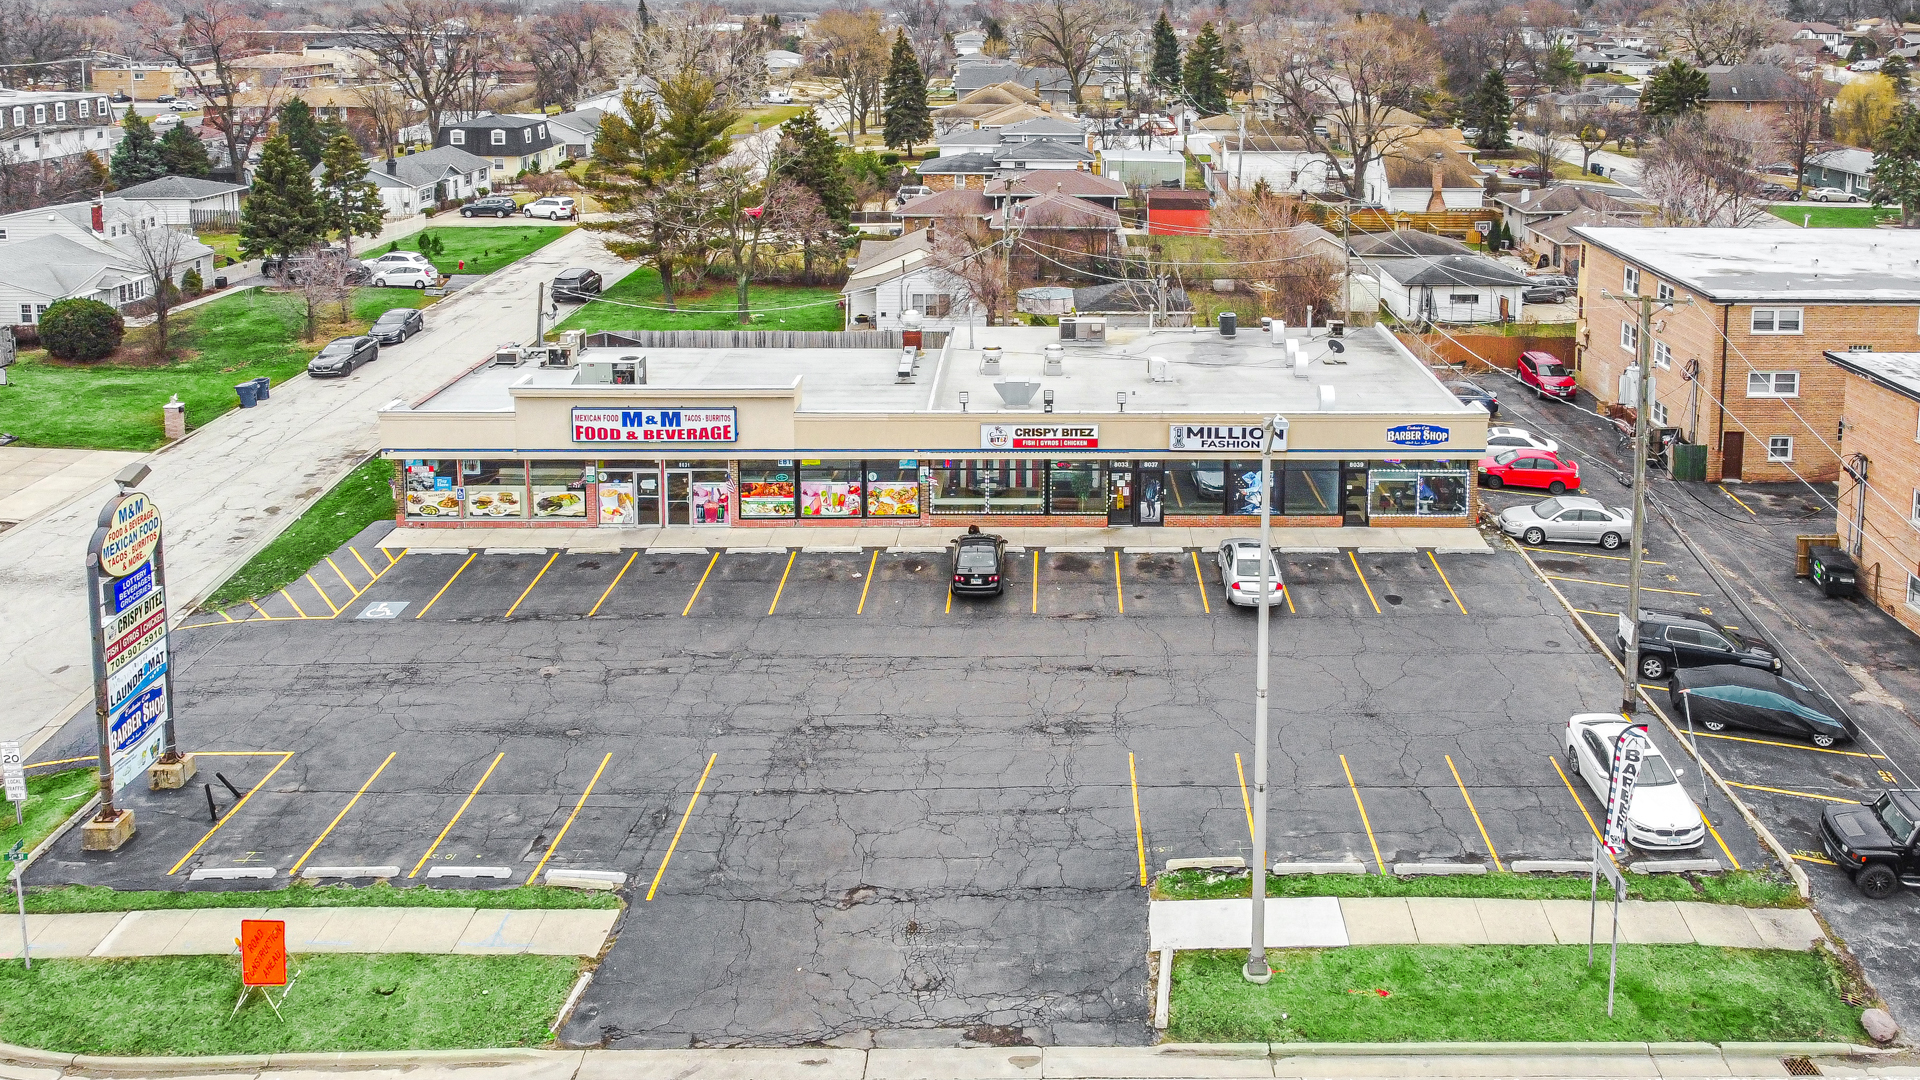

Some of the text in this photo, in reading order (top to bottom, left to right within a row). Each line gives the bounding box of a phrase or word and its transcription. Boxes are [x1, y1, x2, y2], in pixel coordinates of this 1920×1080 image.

[576, 425, 732, 440] FOOD & BEVERAGE
[1015, 428, 1059, 437] CRISPY
[1062, 428, 1094, 437] BITEZ
[1388, 430, 1448, 441] BARBER SHOP
[119, 498, 143, 524] M&M
[103, 517, 158, 560] MEXICAN FOOD
[109, 509, 154, 542] FOOD & BEVERAGE
[108, 550, 127, 568] TACOS
[132, 532, 157, 554] BURRITOS
[123, 562, 127, 571] &
[123, 569, 146, 590] LOTTERY
[119, 575, 151, 600] BEVERAGES
[120, 583, 151, 608] GROCERIES
[118, 591, 162, 634] CRISPY BITEZ
[108, 645, 119, 659] FISH
[123, 629, 140, 647] GYROS
[144, 613, 164, 632] CHICKEN
[110, 626, 162, 671] 708-907-5910
[110, 710, 142, 753] BARBER
[142, 695, 165, 723] SHOP
[3, 754, 19, 763] 20
[1616, 749, 1640, 830] BARBER
[245, 925, 282, 981] CONSTRUCTION
[247, 929, 264, 953] ROAD
[263, 950, 281, 979] AHEAD
